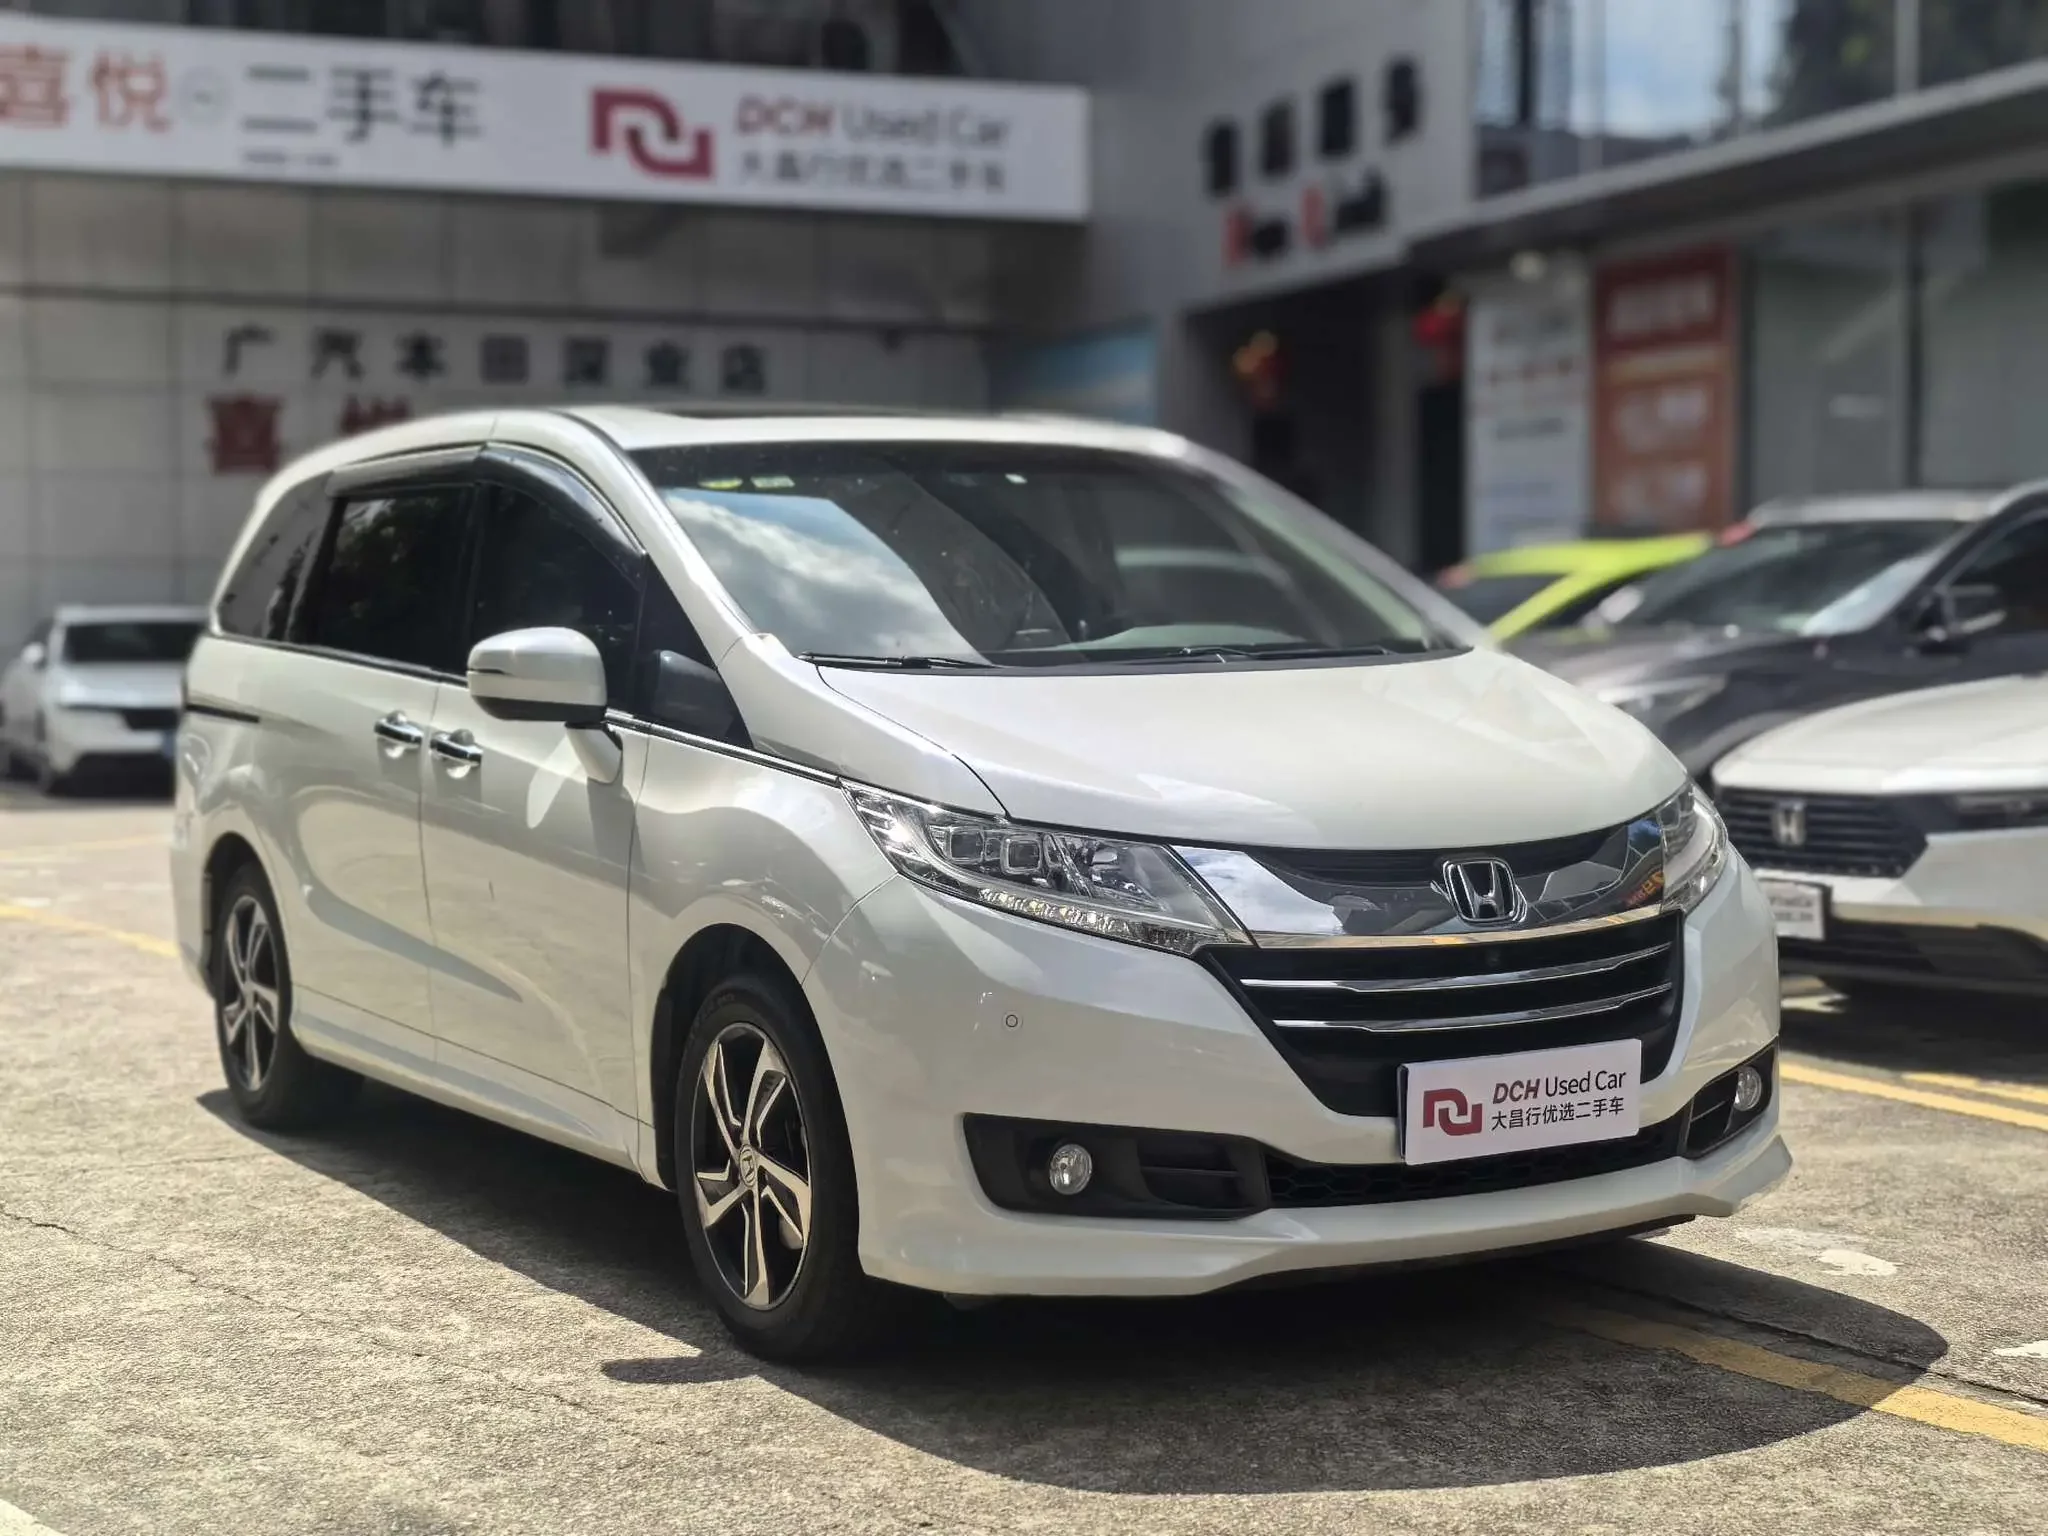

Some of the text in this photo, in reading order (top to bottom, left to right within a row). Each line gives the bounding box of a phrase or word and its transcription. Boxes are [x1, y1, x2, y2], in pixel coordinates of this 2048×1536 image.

[1493, 1070, 1627, 1104] DCH Used Car
[1491, 1096, 1625, 1132] 大昌行优选二手车
